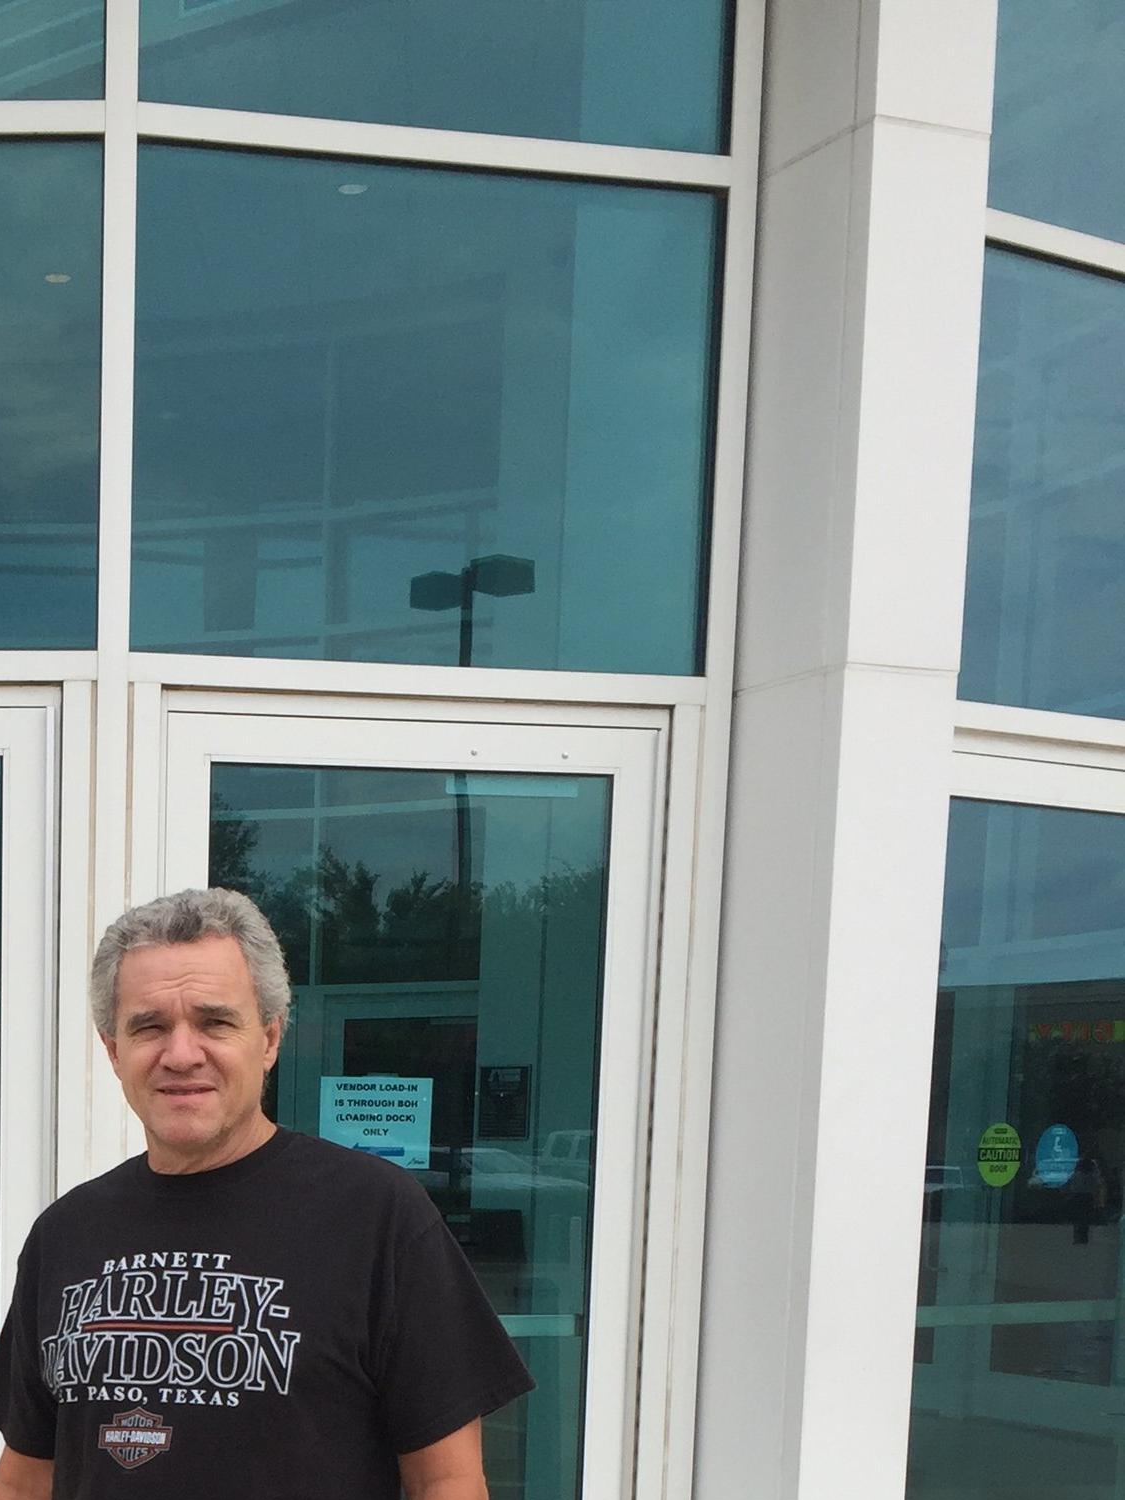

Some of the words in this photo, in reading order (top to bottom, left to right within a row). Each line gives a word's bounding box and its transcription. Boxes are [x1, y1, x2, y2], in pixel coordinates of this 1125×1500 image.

[336, 1083, 377, 1092] VENDOR
[379, 1083, 418, 1092] LOAD-IN
[335, 1099, 345, 1107] IS
[347, 1099, 395, 1108] THROUGH
[397, 1100, 418, 1108] BOH
[336, 1113, 383, 1123] (LOADING
[385, 1114, 416, 1124] DOCK)
[362, 1128, 389, 1136] ONLY
[979, 1149, 1019, 1161] CAUTION
[989, 1164, 1008, 1173] DOOR
[101, 1251, 231, 1275] BARNETT
[59, 1270, 290, 1340] HARLEY-
[41, 1331, 301, 1396] DAVIDSON
[87, 1386, 148, 1405] PASO,
[159, 1388, 240, 1407] TEXAS
